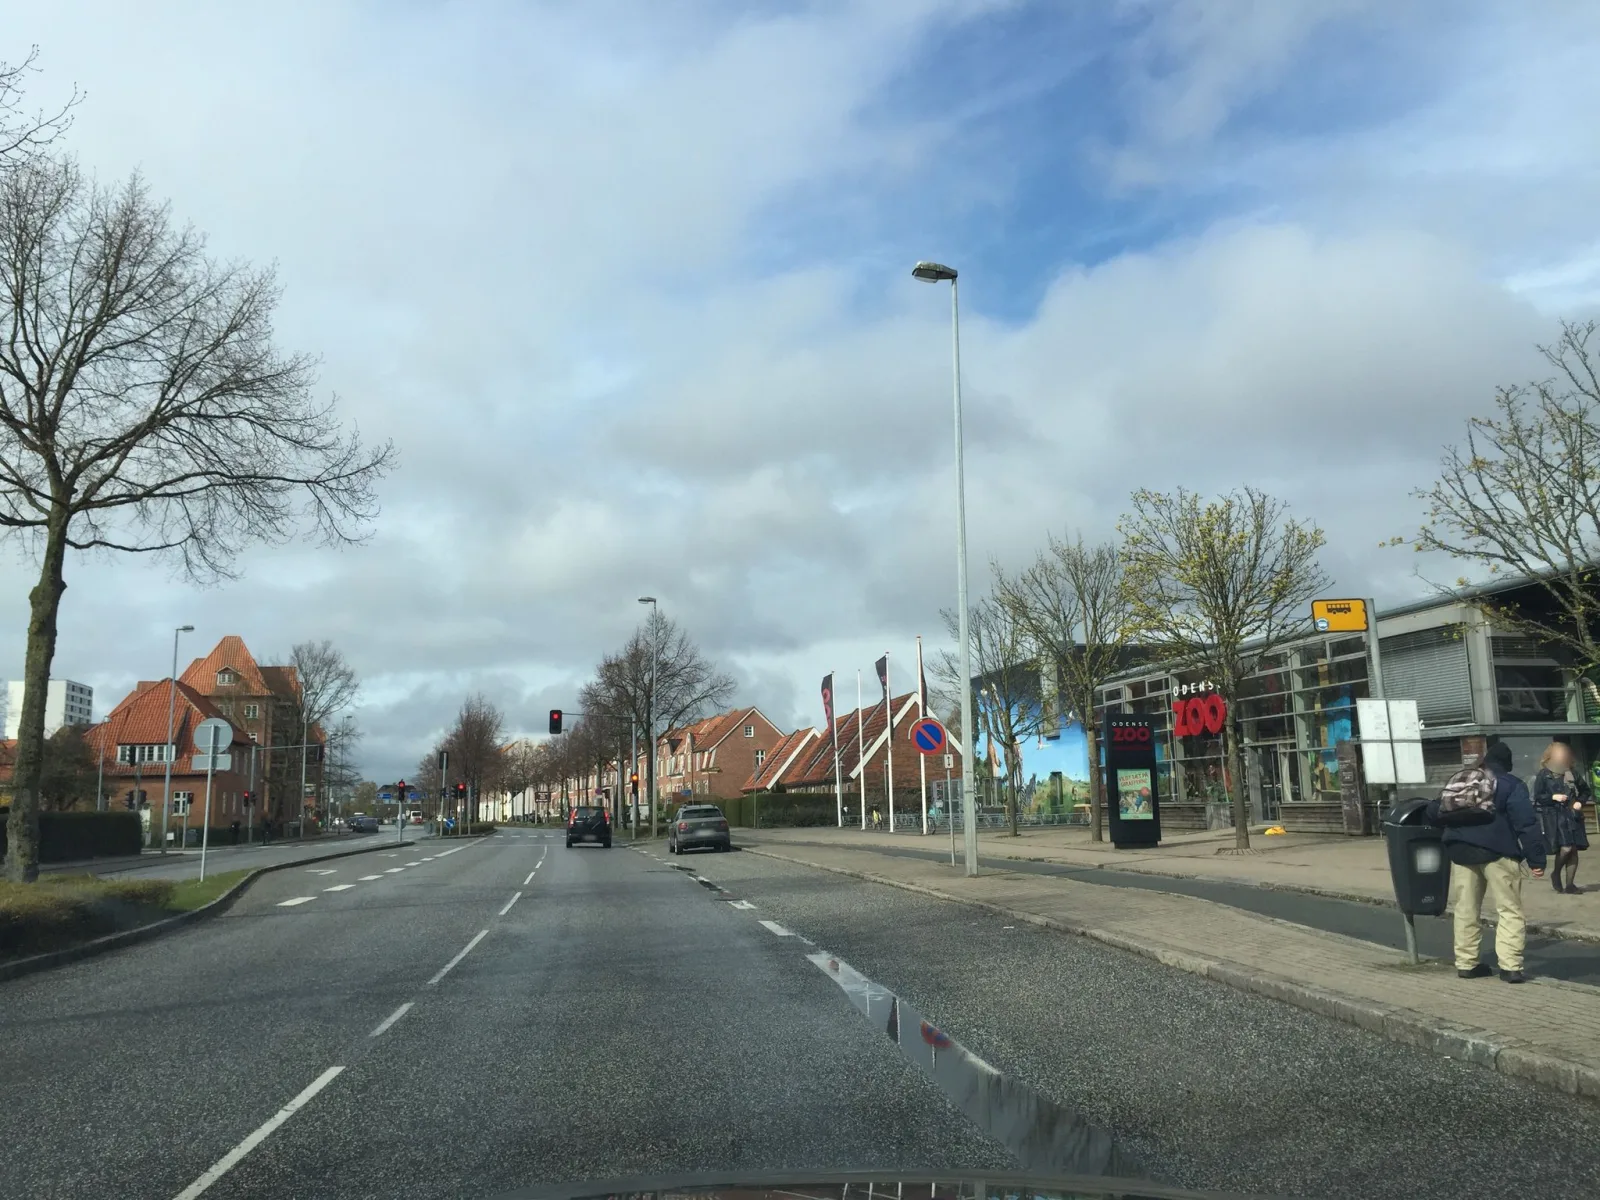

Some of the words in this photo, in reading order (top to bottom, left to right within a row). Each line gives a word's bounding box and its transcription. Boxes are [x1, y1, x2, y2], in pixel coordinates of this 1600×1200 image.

[1173, 681, 1221, 696] ODENS
[1172, 694, 1226, 735] ZOO
[1113, 727, 1150, 741] ZOO
